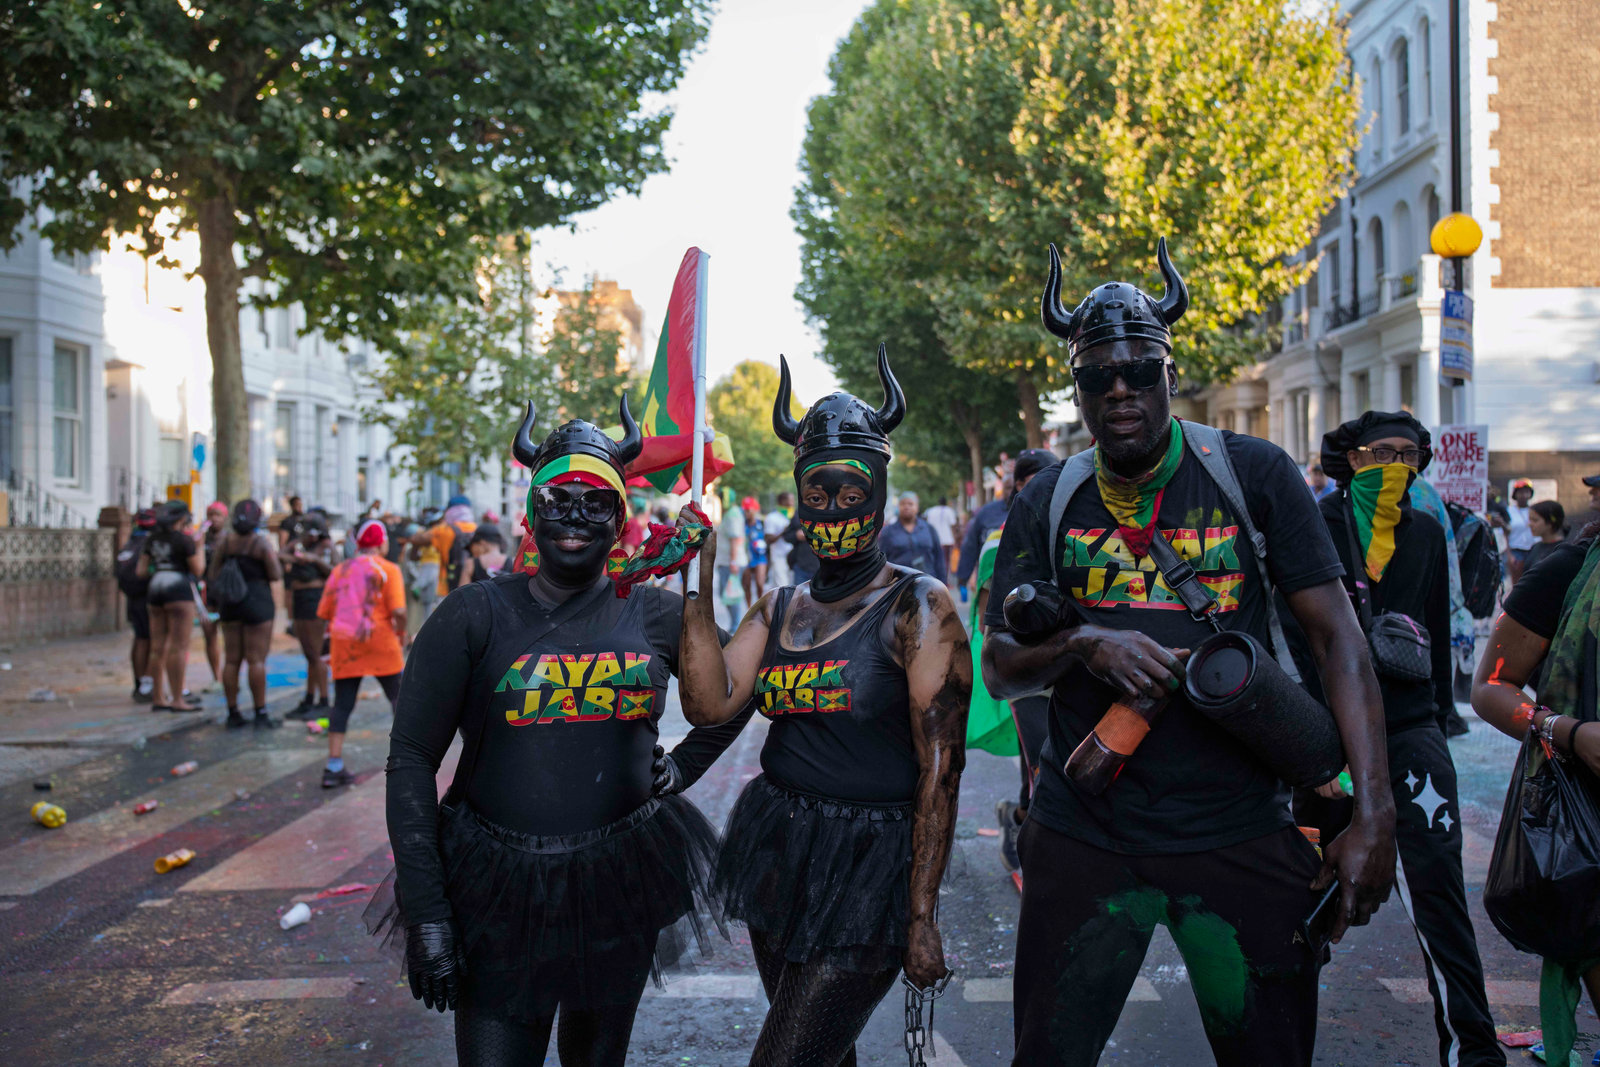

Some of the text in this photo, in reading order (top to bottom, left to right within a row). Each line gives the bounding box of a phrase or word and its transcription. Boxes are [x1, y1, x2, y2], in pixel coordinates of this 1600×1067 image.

[1441, 432, 1478, 448] ONE
[800, 511, 877, 542] KAYAK
[494, 652, 653, 692] KAYAK
[754, 660, 849, 695] KAYAK
[505, 687, 616, 727] JAB
[760, 688, 815, 716] JAB
